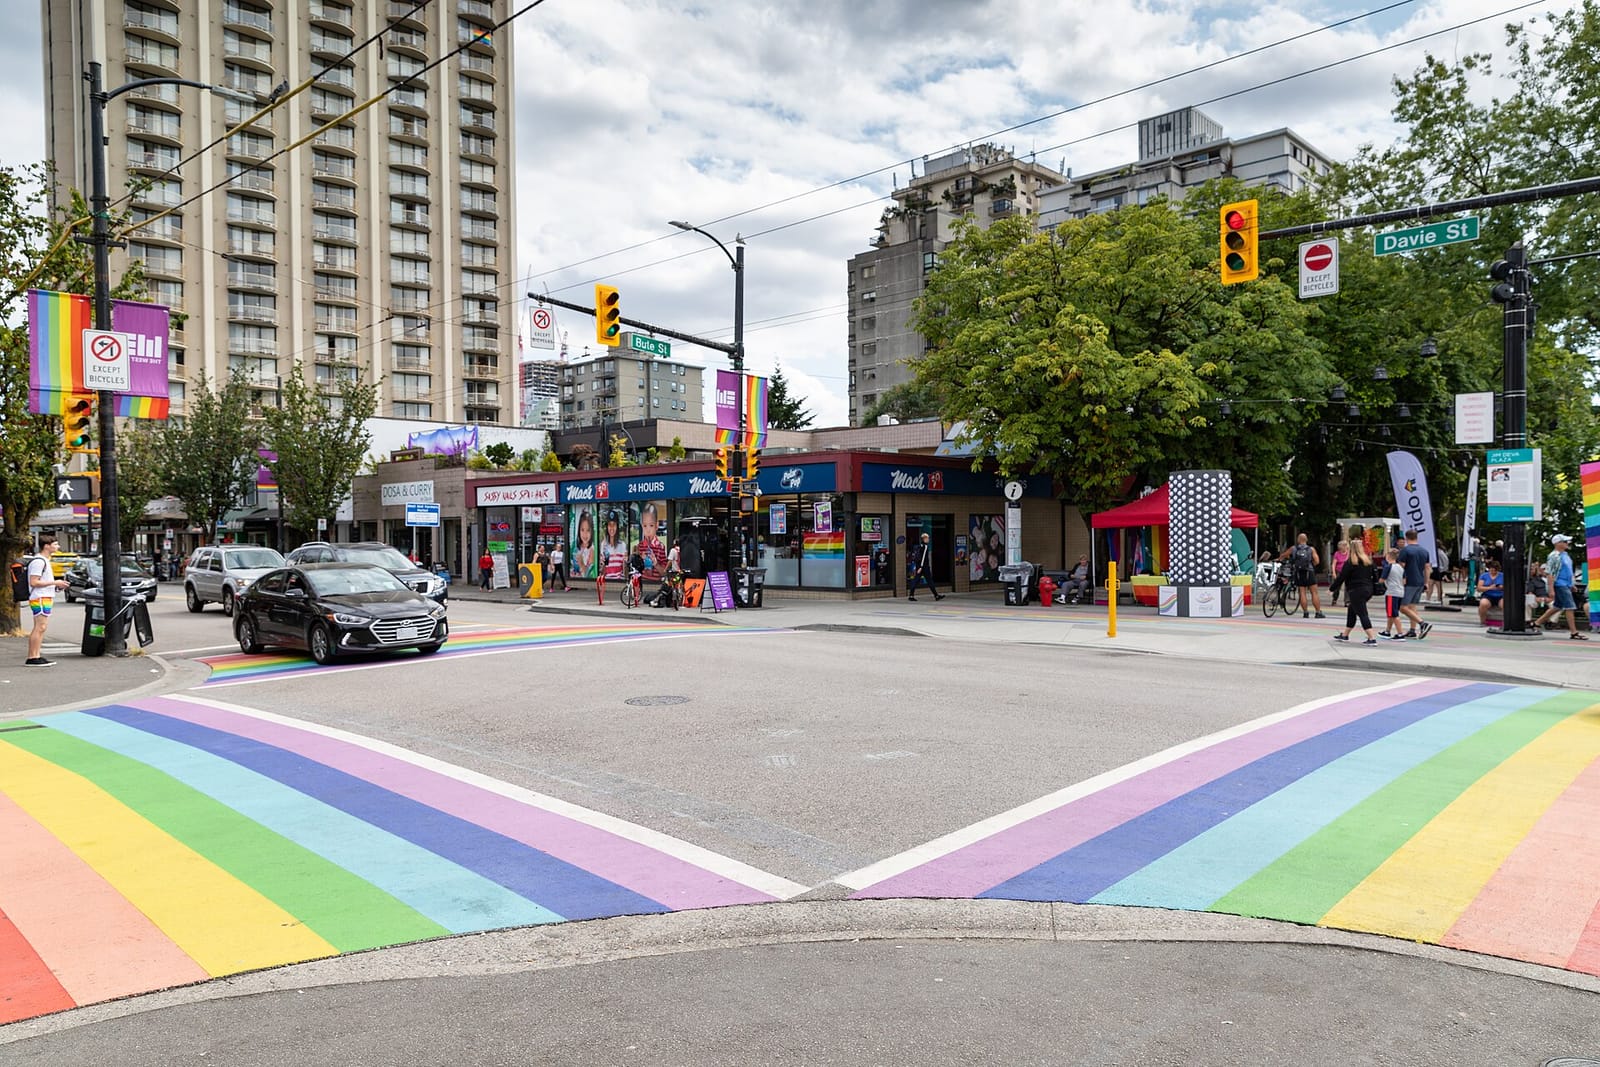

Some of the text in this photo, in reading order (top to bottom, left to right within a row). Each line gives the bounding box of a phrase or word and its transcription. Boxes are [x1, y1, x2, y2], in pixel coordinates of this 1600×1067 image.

[1383, 223, 1469, 251] Davie St
[1306, 273, 1331, 284] EXCEPT
[1303, 281, 1335, 293] BICYCLES
[635, 337, 667, 355] Bute St
[93, 366, 121, 374] EXCEPT
[89, 374, 125, 385] BICYCLES
[628, 481, 665, 493] 24 HOURS
[689, 476, 723, 495] Mac's
[890, 469, 925, 490] Mac's
[383, 483, 432, 498] DOSA & CURRY
[566, 484, 593, 501] Mac's
